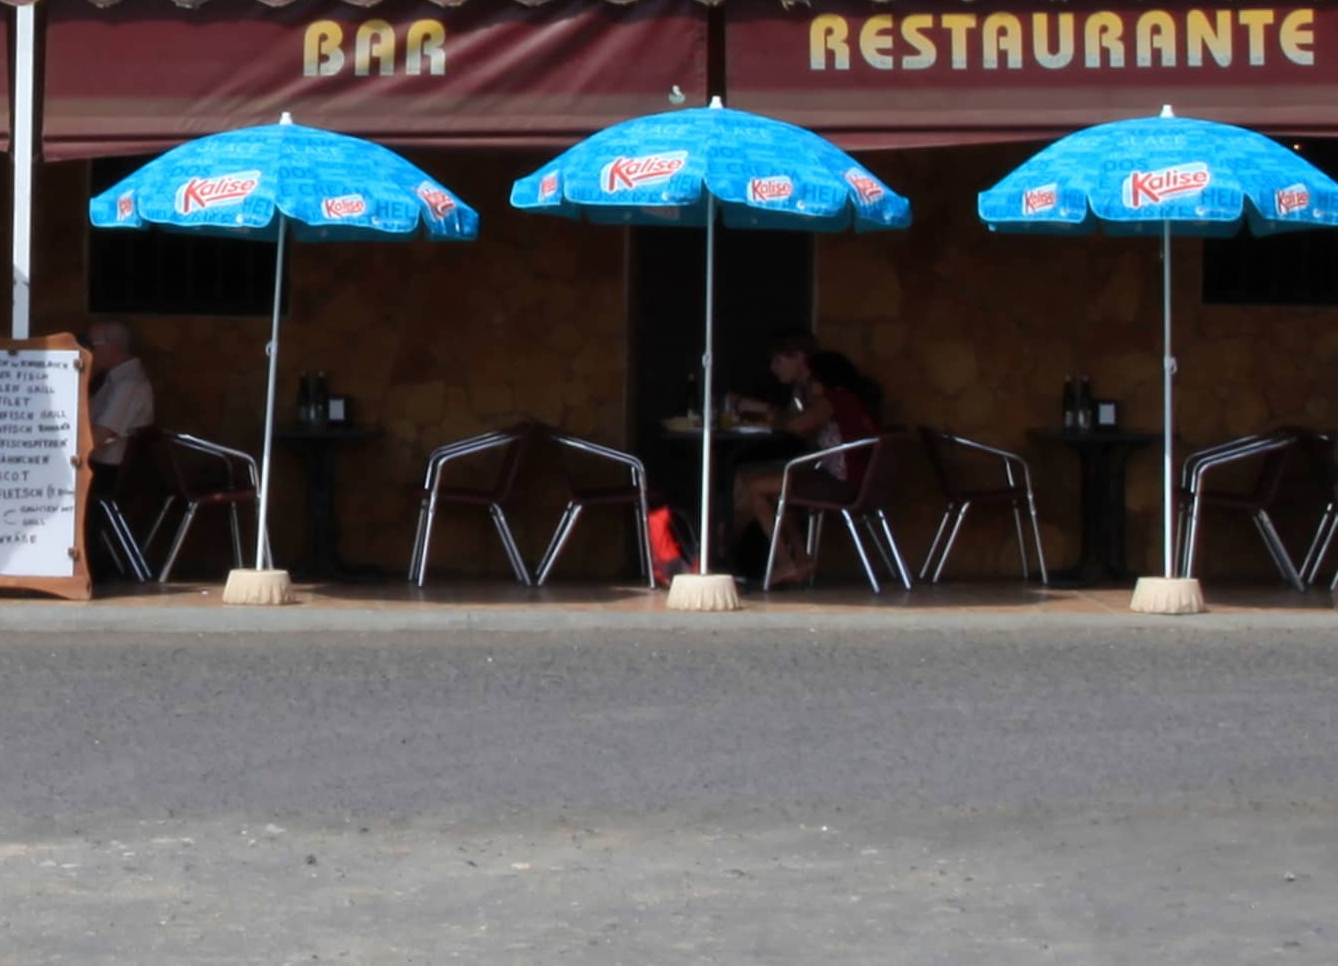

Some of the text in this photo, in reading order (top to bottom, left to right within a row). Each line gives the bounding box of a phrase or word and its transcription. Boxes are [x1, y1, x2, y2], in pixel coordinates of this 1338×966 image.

[303, 19, 446, 76] BAR
[809, 9, 1315, 71] RESTAURANTE
[609, 157, 682, 191] Kalise
[1133, 170, 1208, 206] Kalise
[184, 177, 256, 212] Kalise
